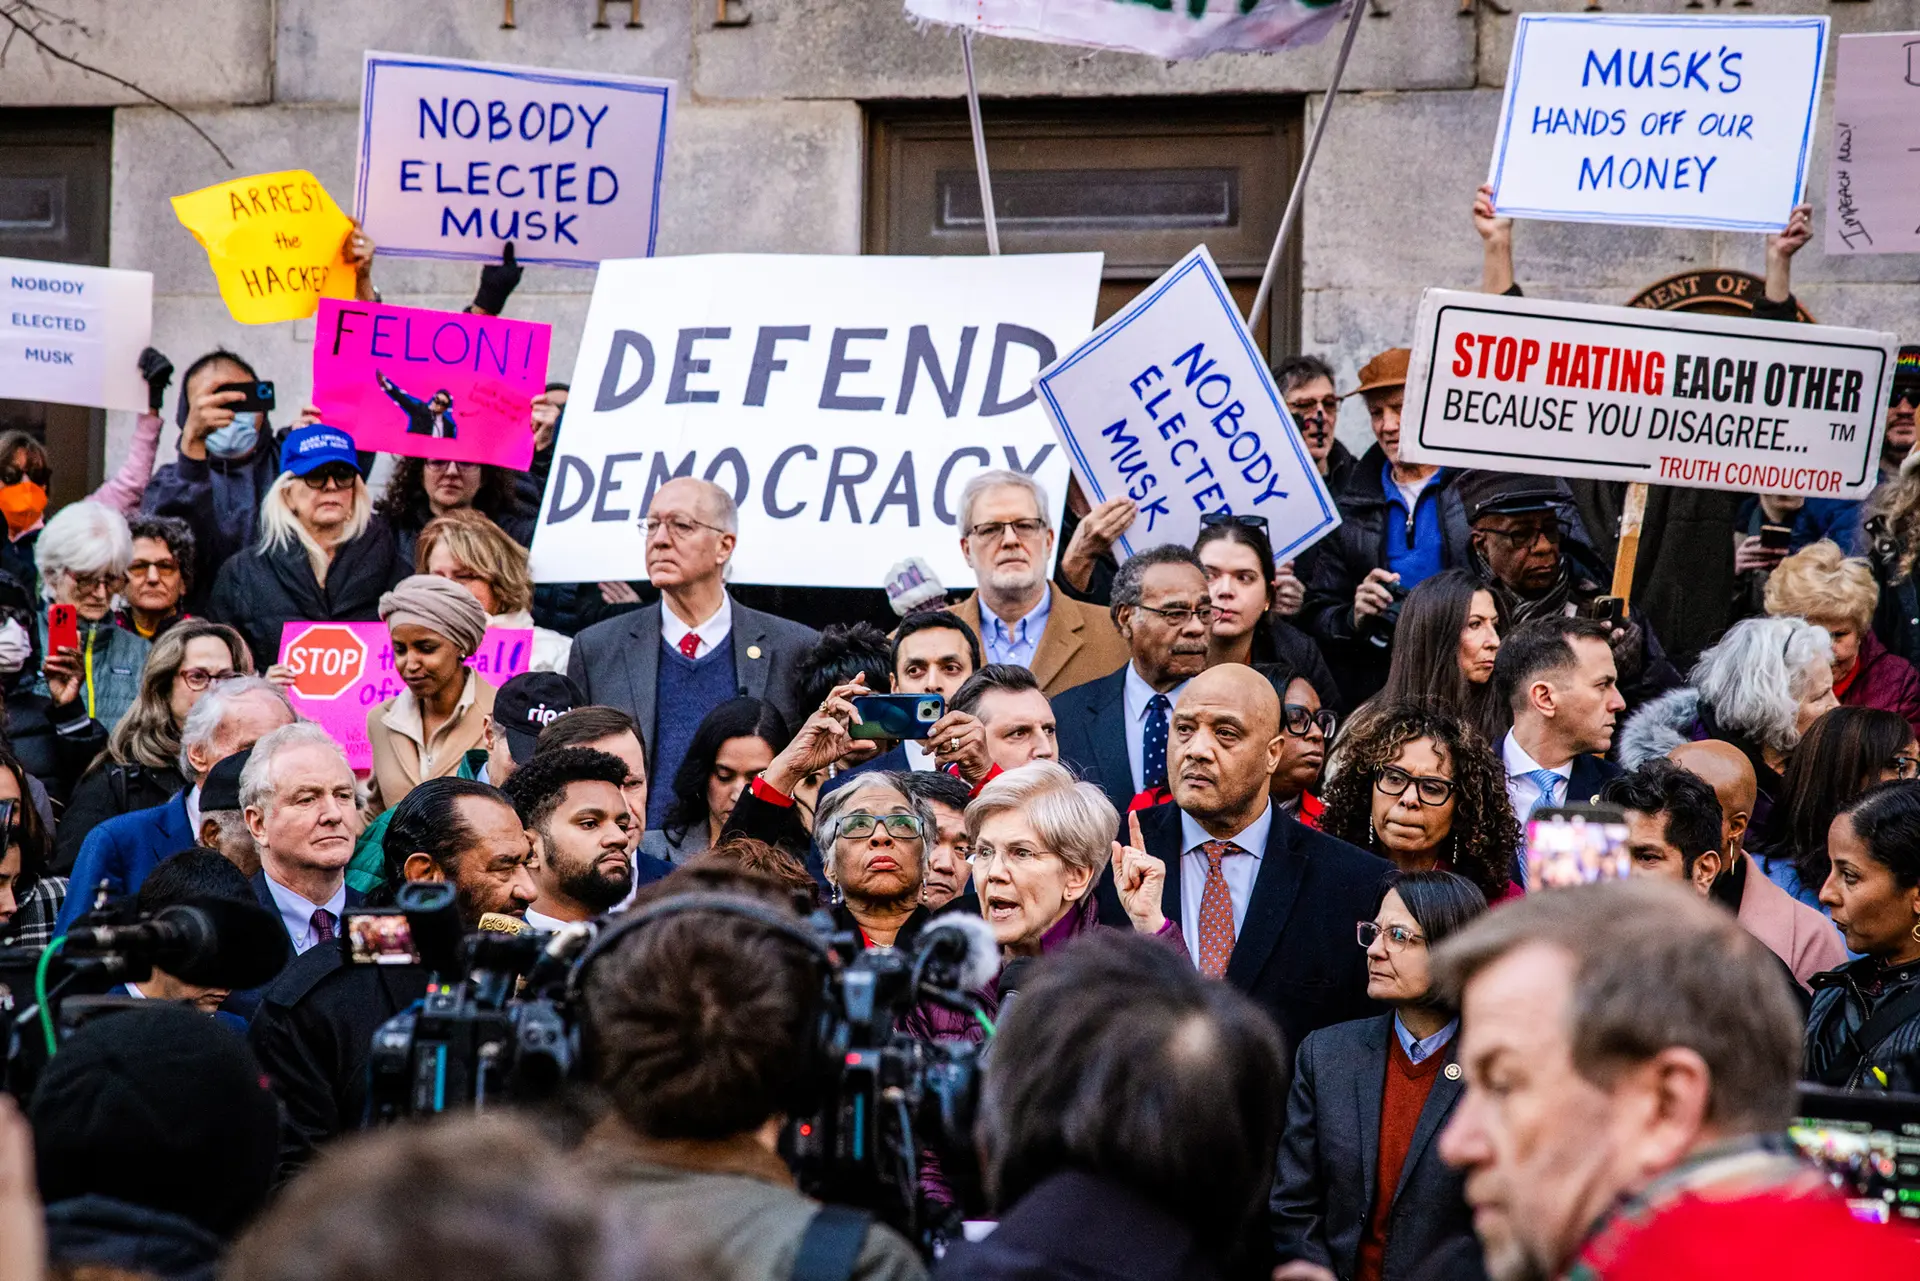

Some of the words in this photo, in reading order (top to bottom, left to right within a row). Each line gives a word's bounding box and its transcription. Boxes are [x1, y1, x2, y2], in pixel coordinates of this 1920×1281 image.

[1582, 45, 1743, 93] MUSK'S
[419, 97, 609, 149] NOBODY
[1532, 106, 1626, 138] HANDS
[1641, 110, 1686, 137] OFF
[1699, 113, 1754, 140] OUR
[400, 160, 619, 205] ELECTED
[1578, 155, 1718, 193] MONEY
[229, 182, 324, 221] ARREST
[273, 231, 302, 250] the
[441, 206, 579, 245] MUSK
[11, 276, 84, 295] NOBODY
[1715, 274, 1751, 296] OF
[11, 312, 86, 332] ELECTED
[25, 346, 74, 365] MUSK
[332, 309, 534, 380] FELON!
[593, 323, 1058, 418] DEFEND
[1452, 332, 1540, 384] STOP
[1544, 341, 1666, 397] HATING
[1672, 354, 1758, 406] EACH
[1764, 362, 1864, 413] OTHER
[1172, 342, 1289, 506] NOBODY
[1443, 388, 1578, 433] BECAUSE
[1587, 402, 1641, 438] YOU
[1648, 408, 1809, 454] DISAGREE...
[1829, 422, 1857, 442] TM
[1102, 418, 1169, 532] MUSK
[1658, 456, 1721, 485] TRUTH
[1725, 462, 1843, 493] CONDUCTOR
[288, 647, 359, 676] STOP
